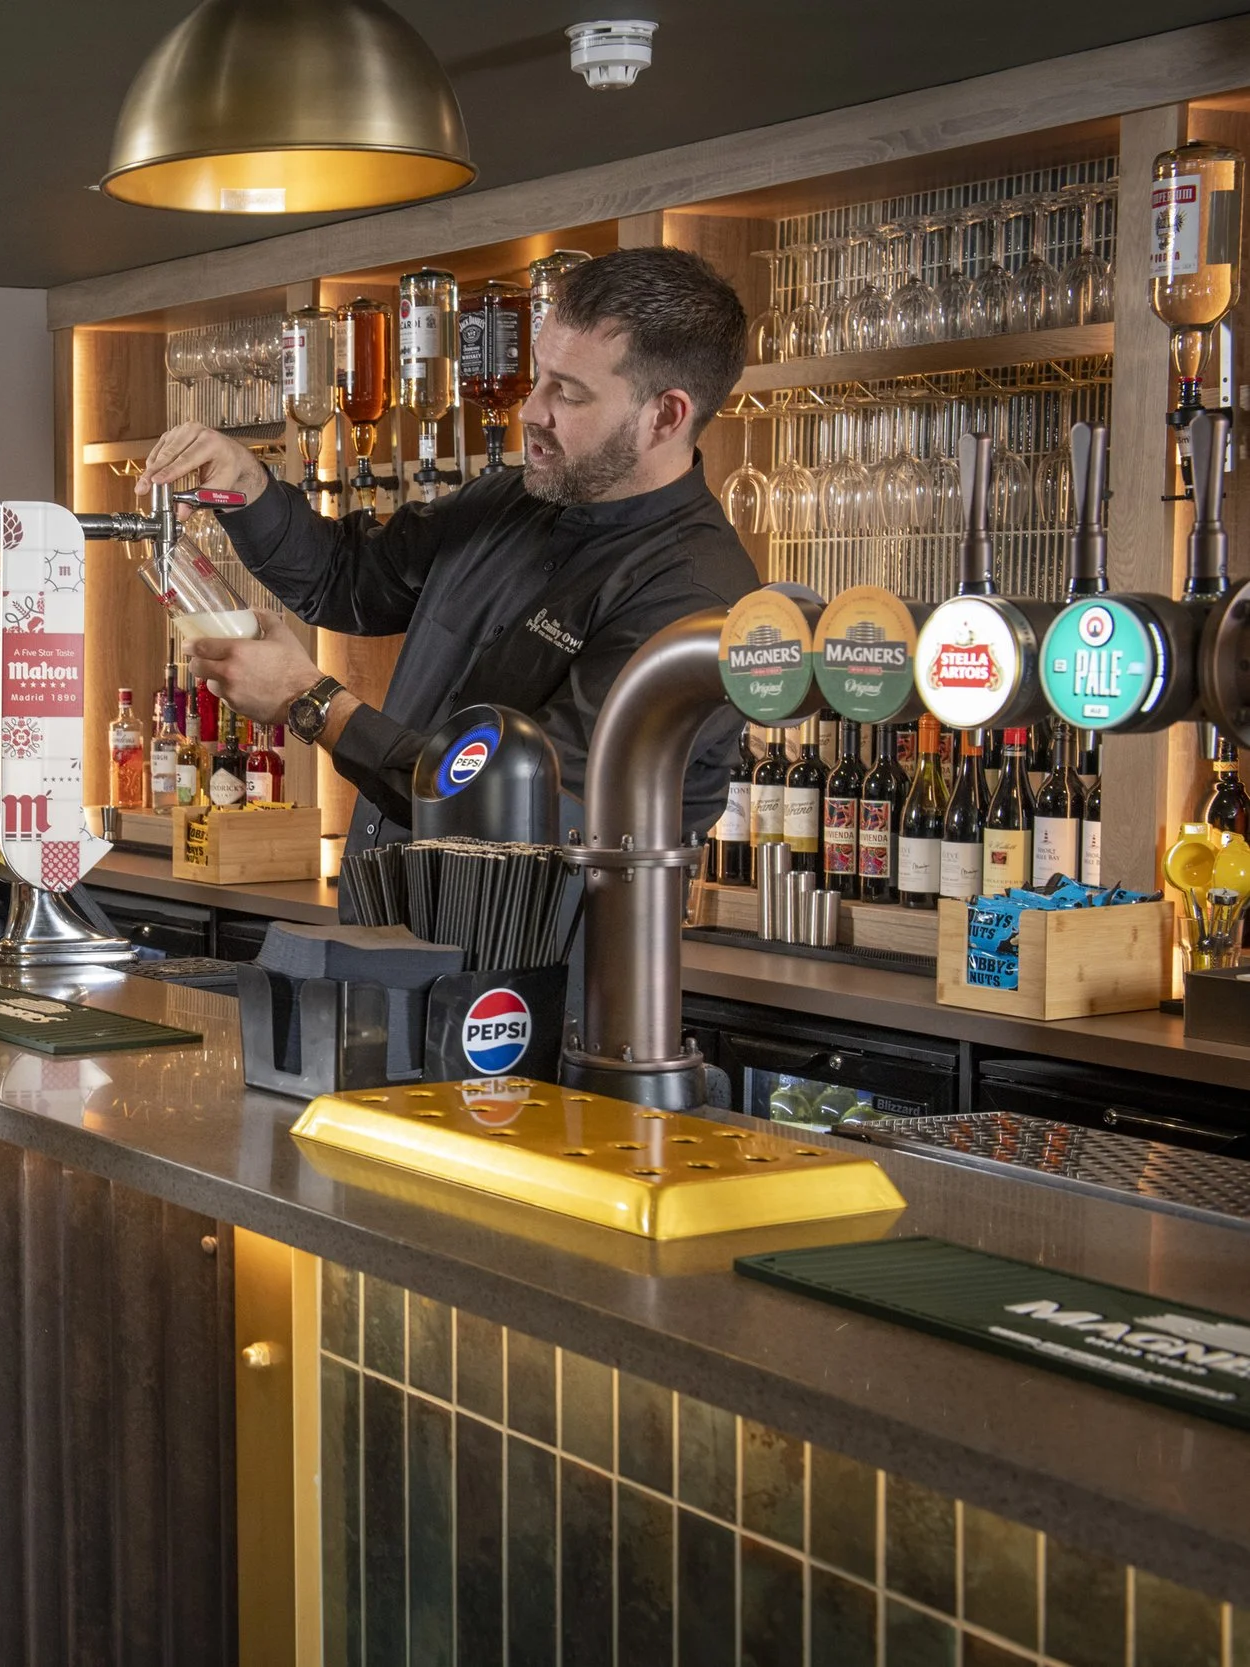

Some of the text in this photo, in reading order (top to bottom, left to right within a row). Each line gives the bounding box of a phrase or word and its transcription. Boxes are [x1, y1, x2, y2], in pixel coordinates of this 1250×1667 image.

[13, 648, 75, 657] A Five Star Taste
[729, 644, 801, 669] MAGNERS
[825, 643, 906, 666] MAGNERS
[940, 652, 989, 666] STELLA
[7, 660, 79, 681] Mahou
[939, 665, 989, 680] ARTOIS
[1073, 648, 1124, 698] PALE
[11, 693, 76, 702] Madrid 1890
[749, 679, 784, 699] Original
[844, 678, 884, 698] Original
[455, 757, 483, 768] PEPSI
[969, 971, 1001, 987] NUTS
[466, 1020, 528, 1042] PEPSI
[877, 1098, 922, 1117] Blizzard
